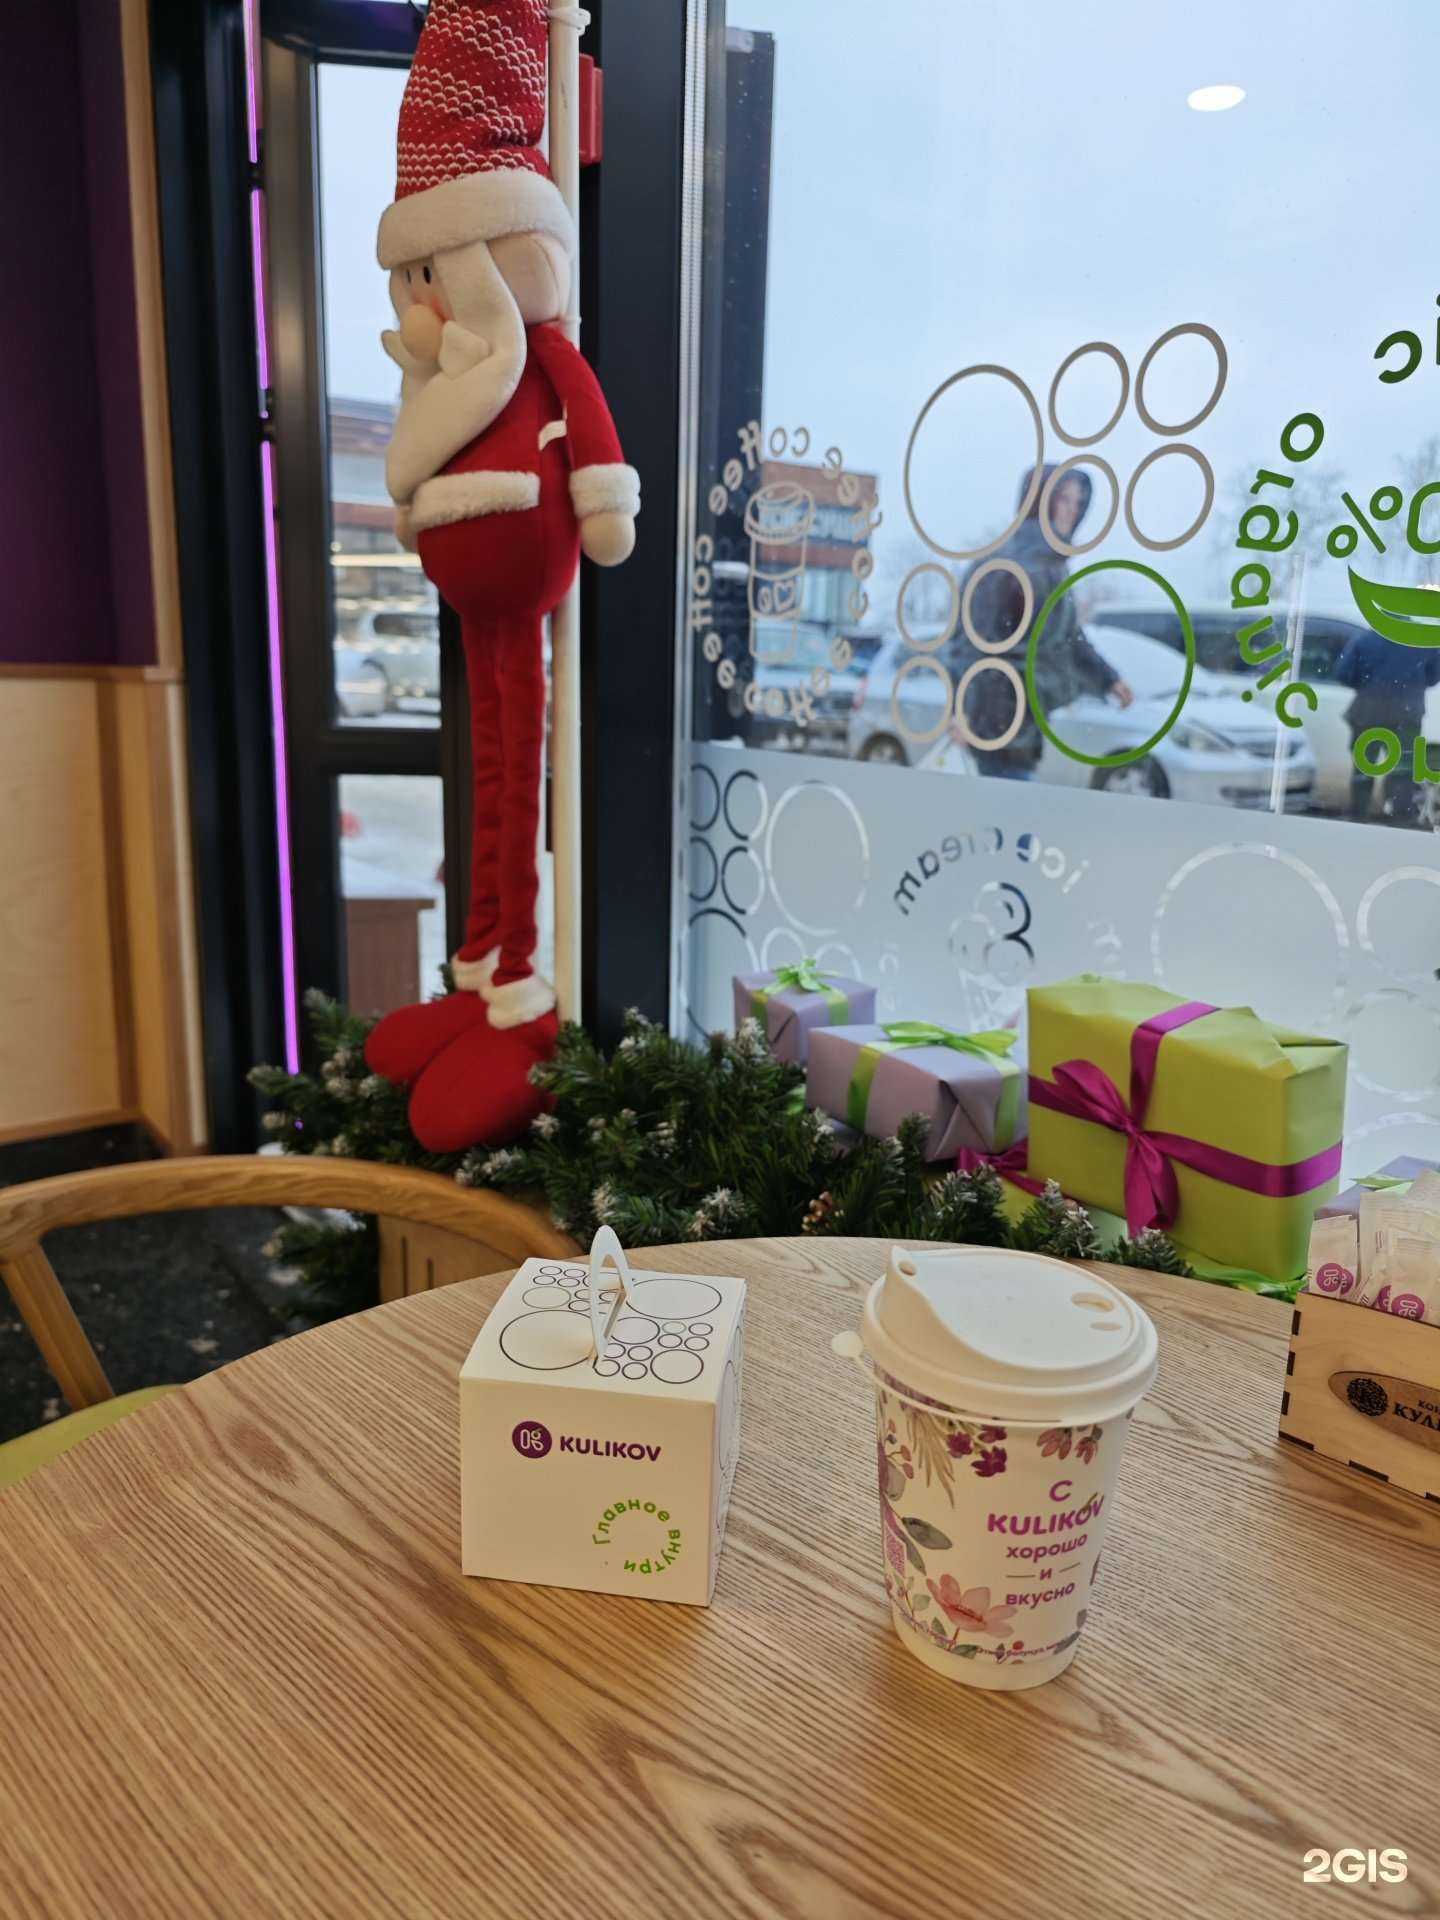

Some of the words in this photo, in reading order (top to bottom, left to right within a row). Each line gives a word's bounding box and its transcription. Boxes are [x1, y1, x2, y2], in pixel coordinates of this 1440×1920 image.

[560, 1435, 661, 1462] KULIKOV
[592, 1499, 670, 1545] Главное
[987, 1494, 1105, 1536] KULIKOV
[623, 1529, 681, 1575] внутри
[1006, 1534, 1088, 1563] хорошо
[1006, 1582, 1076, 1609] вкусно
